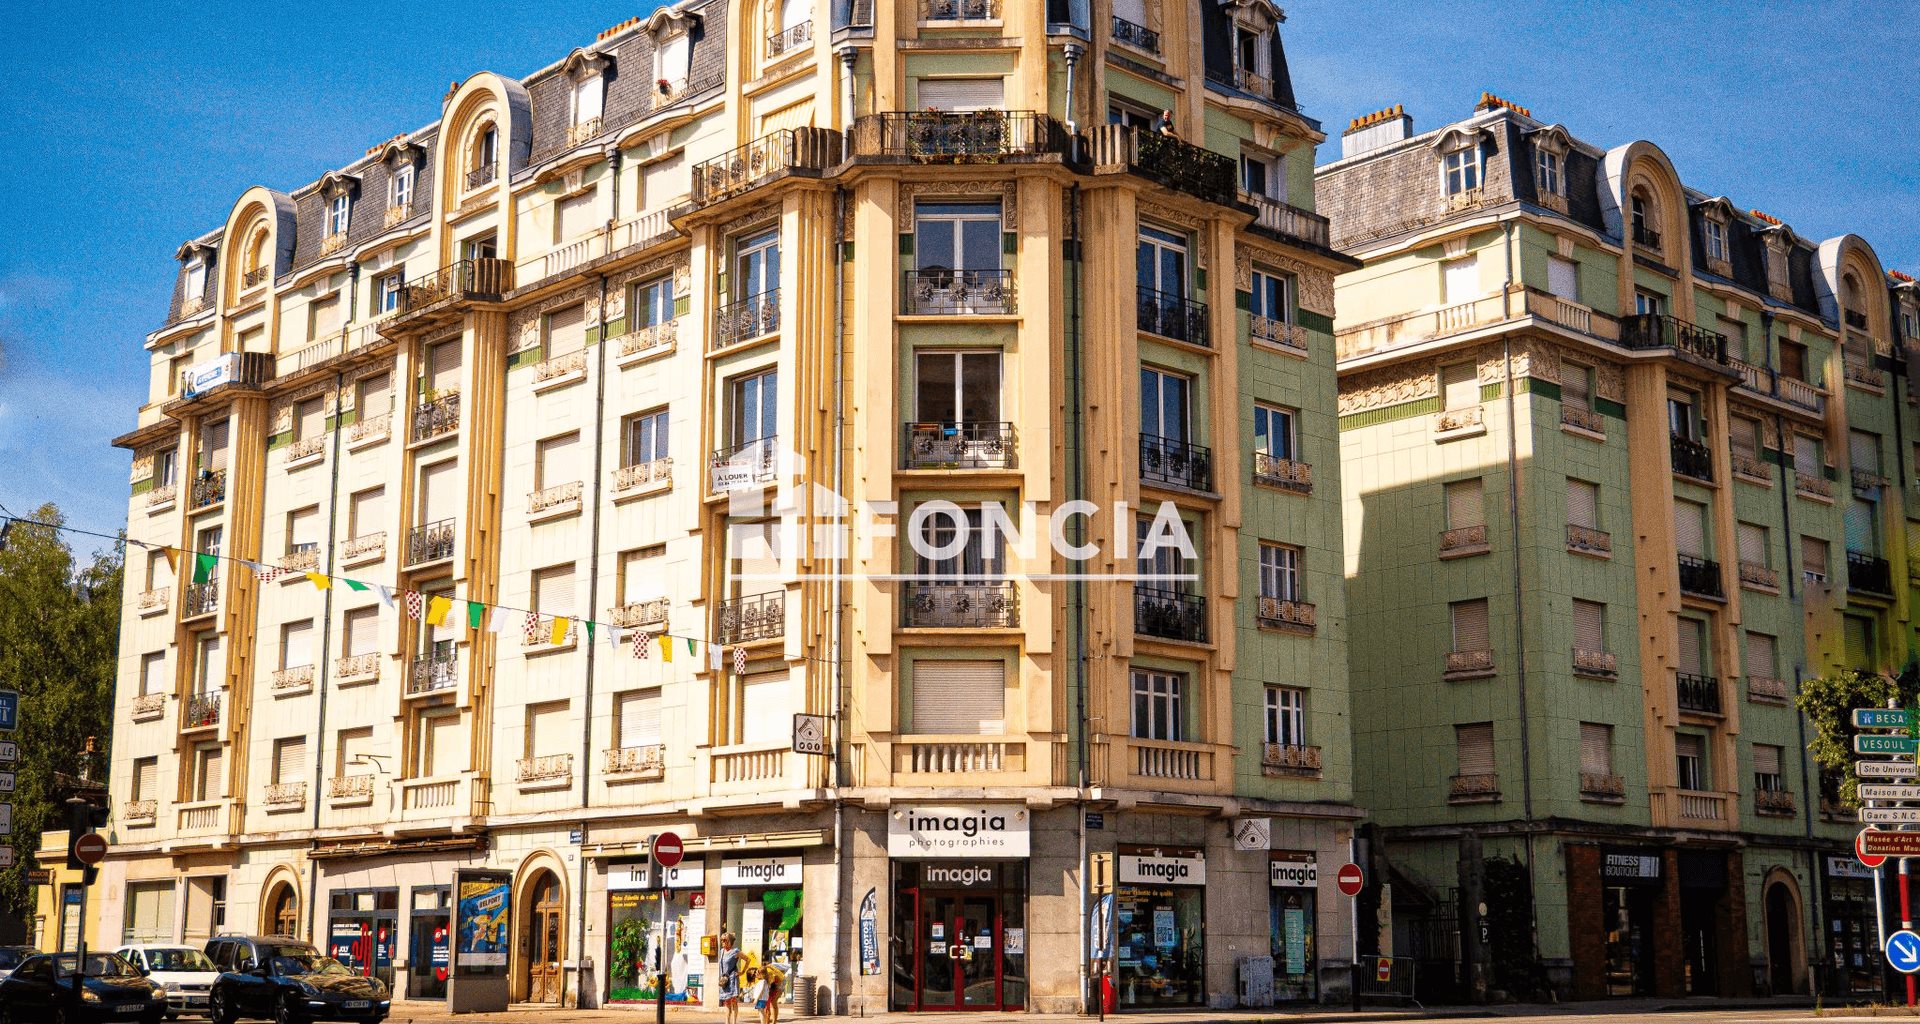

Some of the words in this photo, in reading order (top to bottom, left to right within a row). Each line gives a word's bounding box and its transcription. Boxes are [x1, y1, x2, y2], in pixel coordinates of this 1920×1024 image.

[1862, 739, 1905, 750] VESOUL
[0, 747, 13, 757] LE
[1863, 765, 1880, 774] Site
[1865, 788, 1897, 797] Maison
[1901, 788, 1912, 797] du
[1866, 811, 1888, 820] Gare
[909, 810, 1006, 837] imagia
[909, 837, 1005, 849] photographies
[1867, 835, 1890, 843] Musée
[1893, 835, 1912, 843] d'Art
[1867, 844, 1901, 852] Donation
[1606, 854, 1639, 866] FITNESS
[630, 864, 679, 882] ima
[737, 859, 785, 883] imagia
[927, 865, 992, 886] imagia
[1137, 857, 1189, 882] imagia
[1272, 862, 1317, 886] imagia
[1606, 865, 1639, 877] BOUTIQUE
